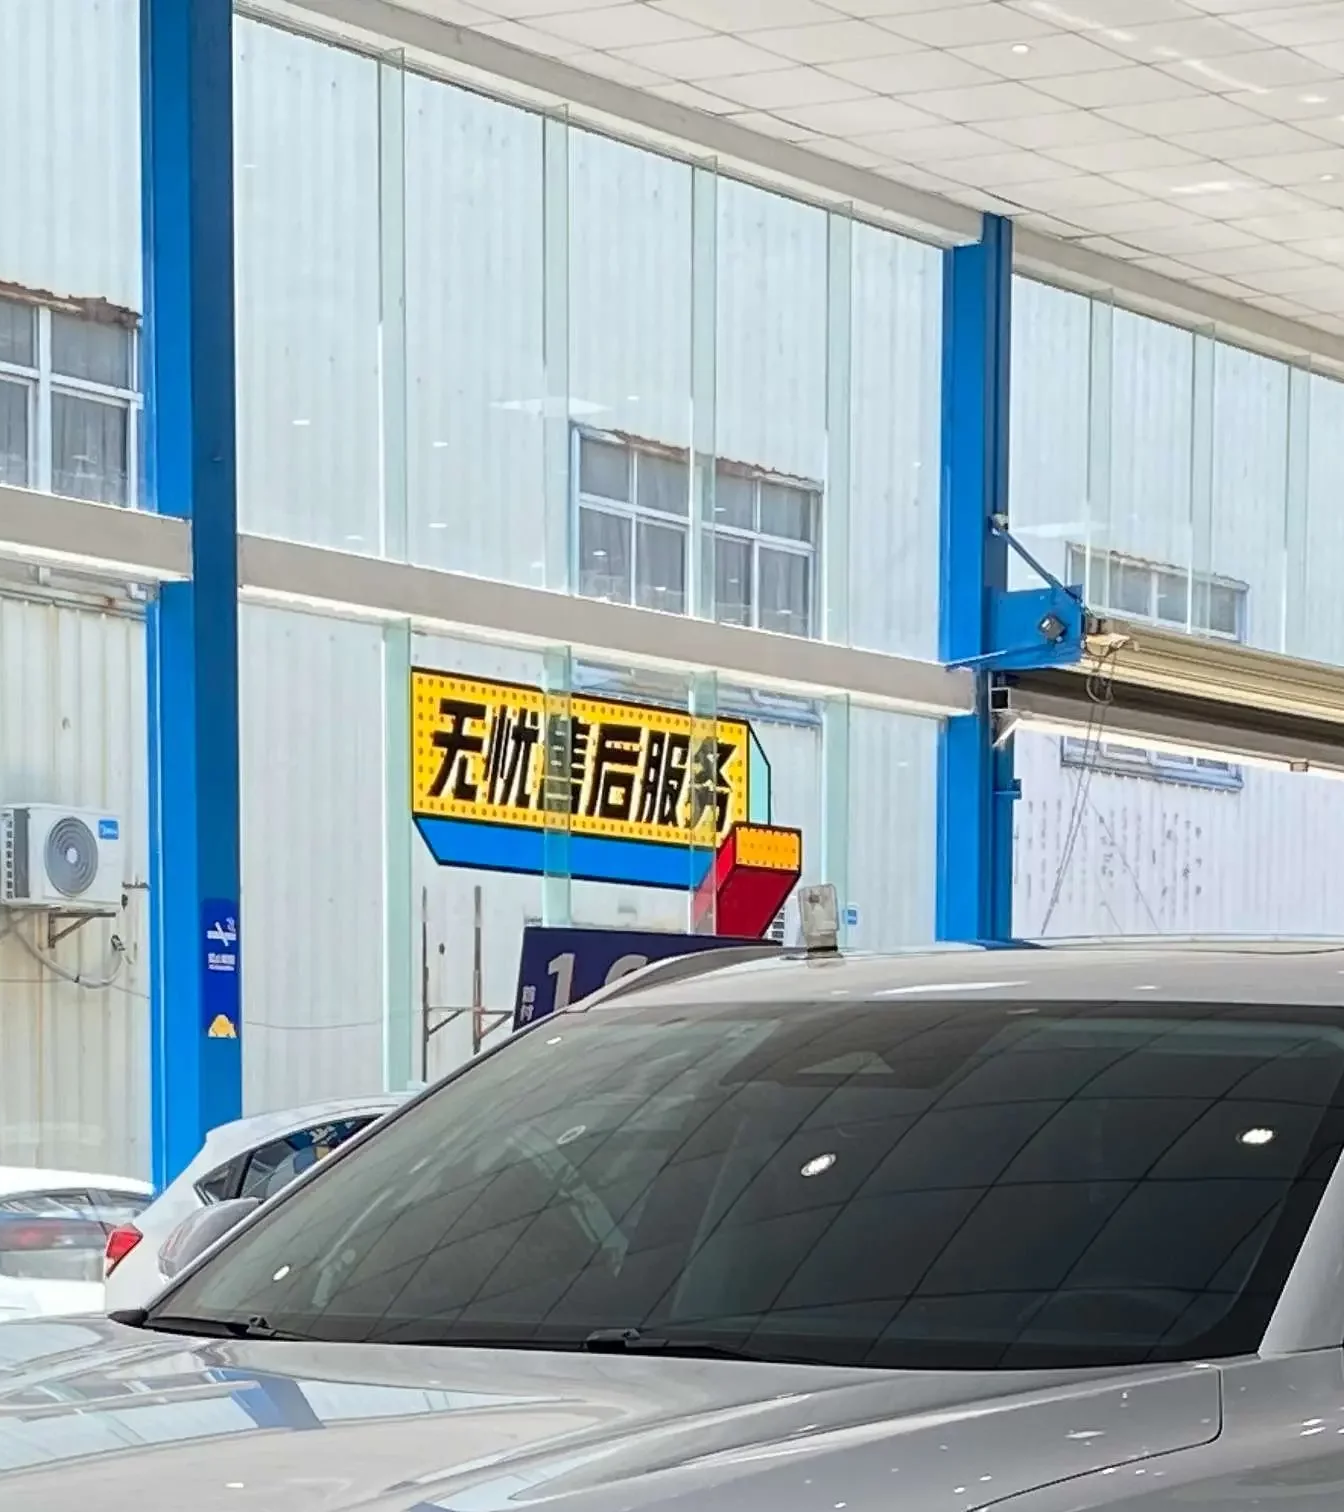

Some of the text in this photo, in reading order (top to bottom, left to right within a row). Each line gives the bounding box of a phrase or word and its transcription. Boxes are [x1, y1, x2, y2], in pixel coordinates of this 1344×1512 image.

[428, 699, 736, 829] 无忧售后服务
